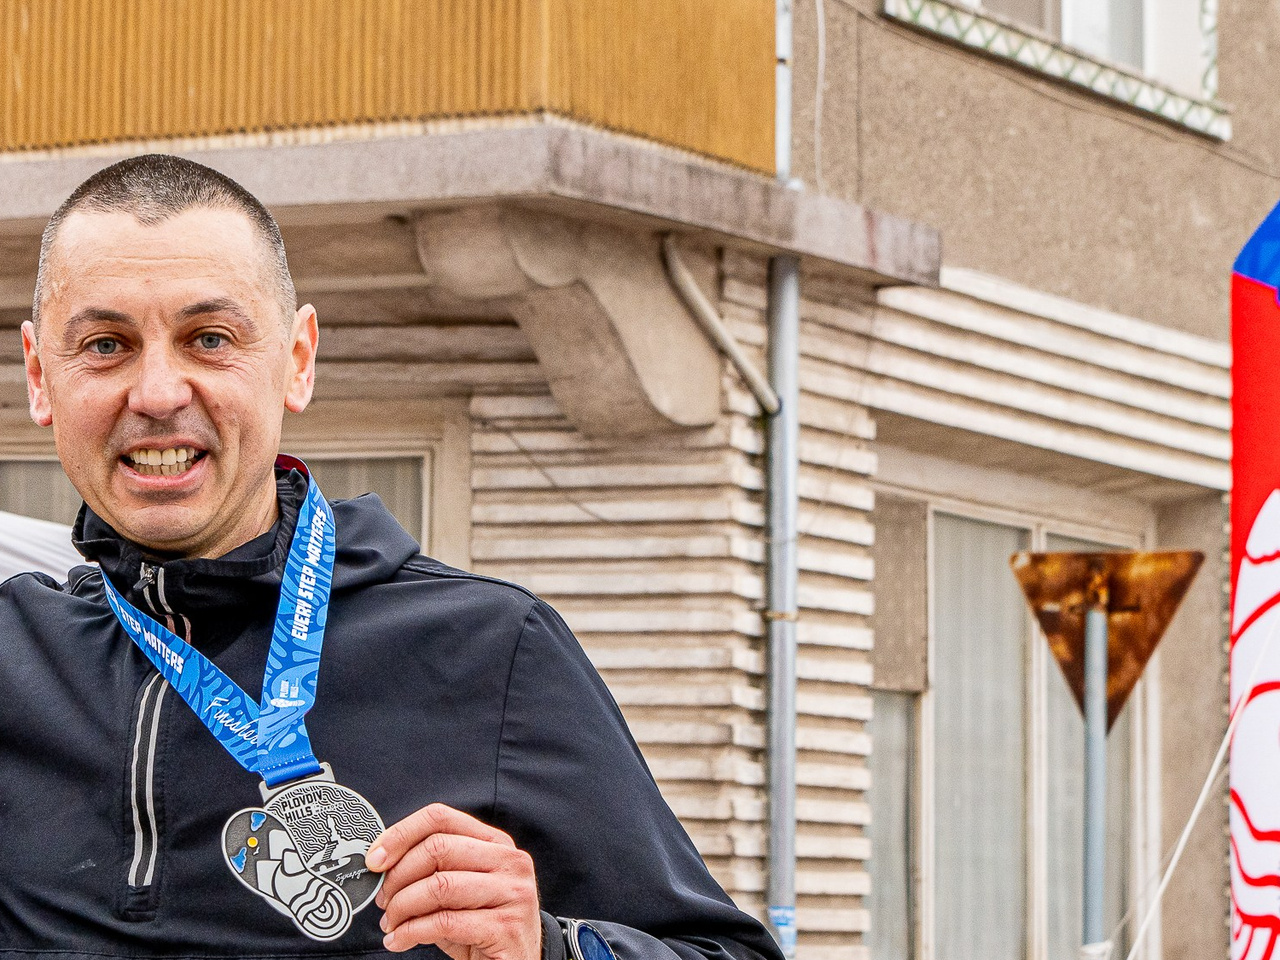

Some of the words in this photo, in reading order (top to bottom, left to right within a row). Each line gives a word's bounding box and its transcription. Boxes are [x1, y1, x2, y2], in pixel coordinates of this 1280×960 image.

[305, 506, 327, 567] MATTERS
[298, 564, 317, 600] STEP
[143, 627, 185, 674] MATTERS
[281, 790, 322, 811] PLOVDIV
[285, 806, 313, 823] HILLS
